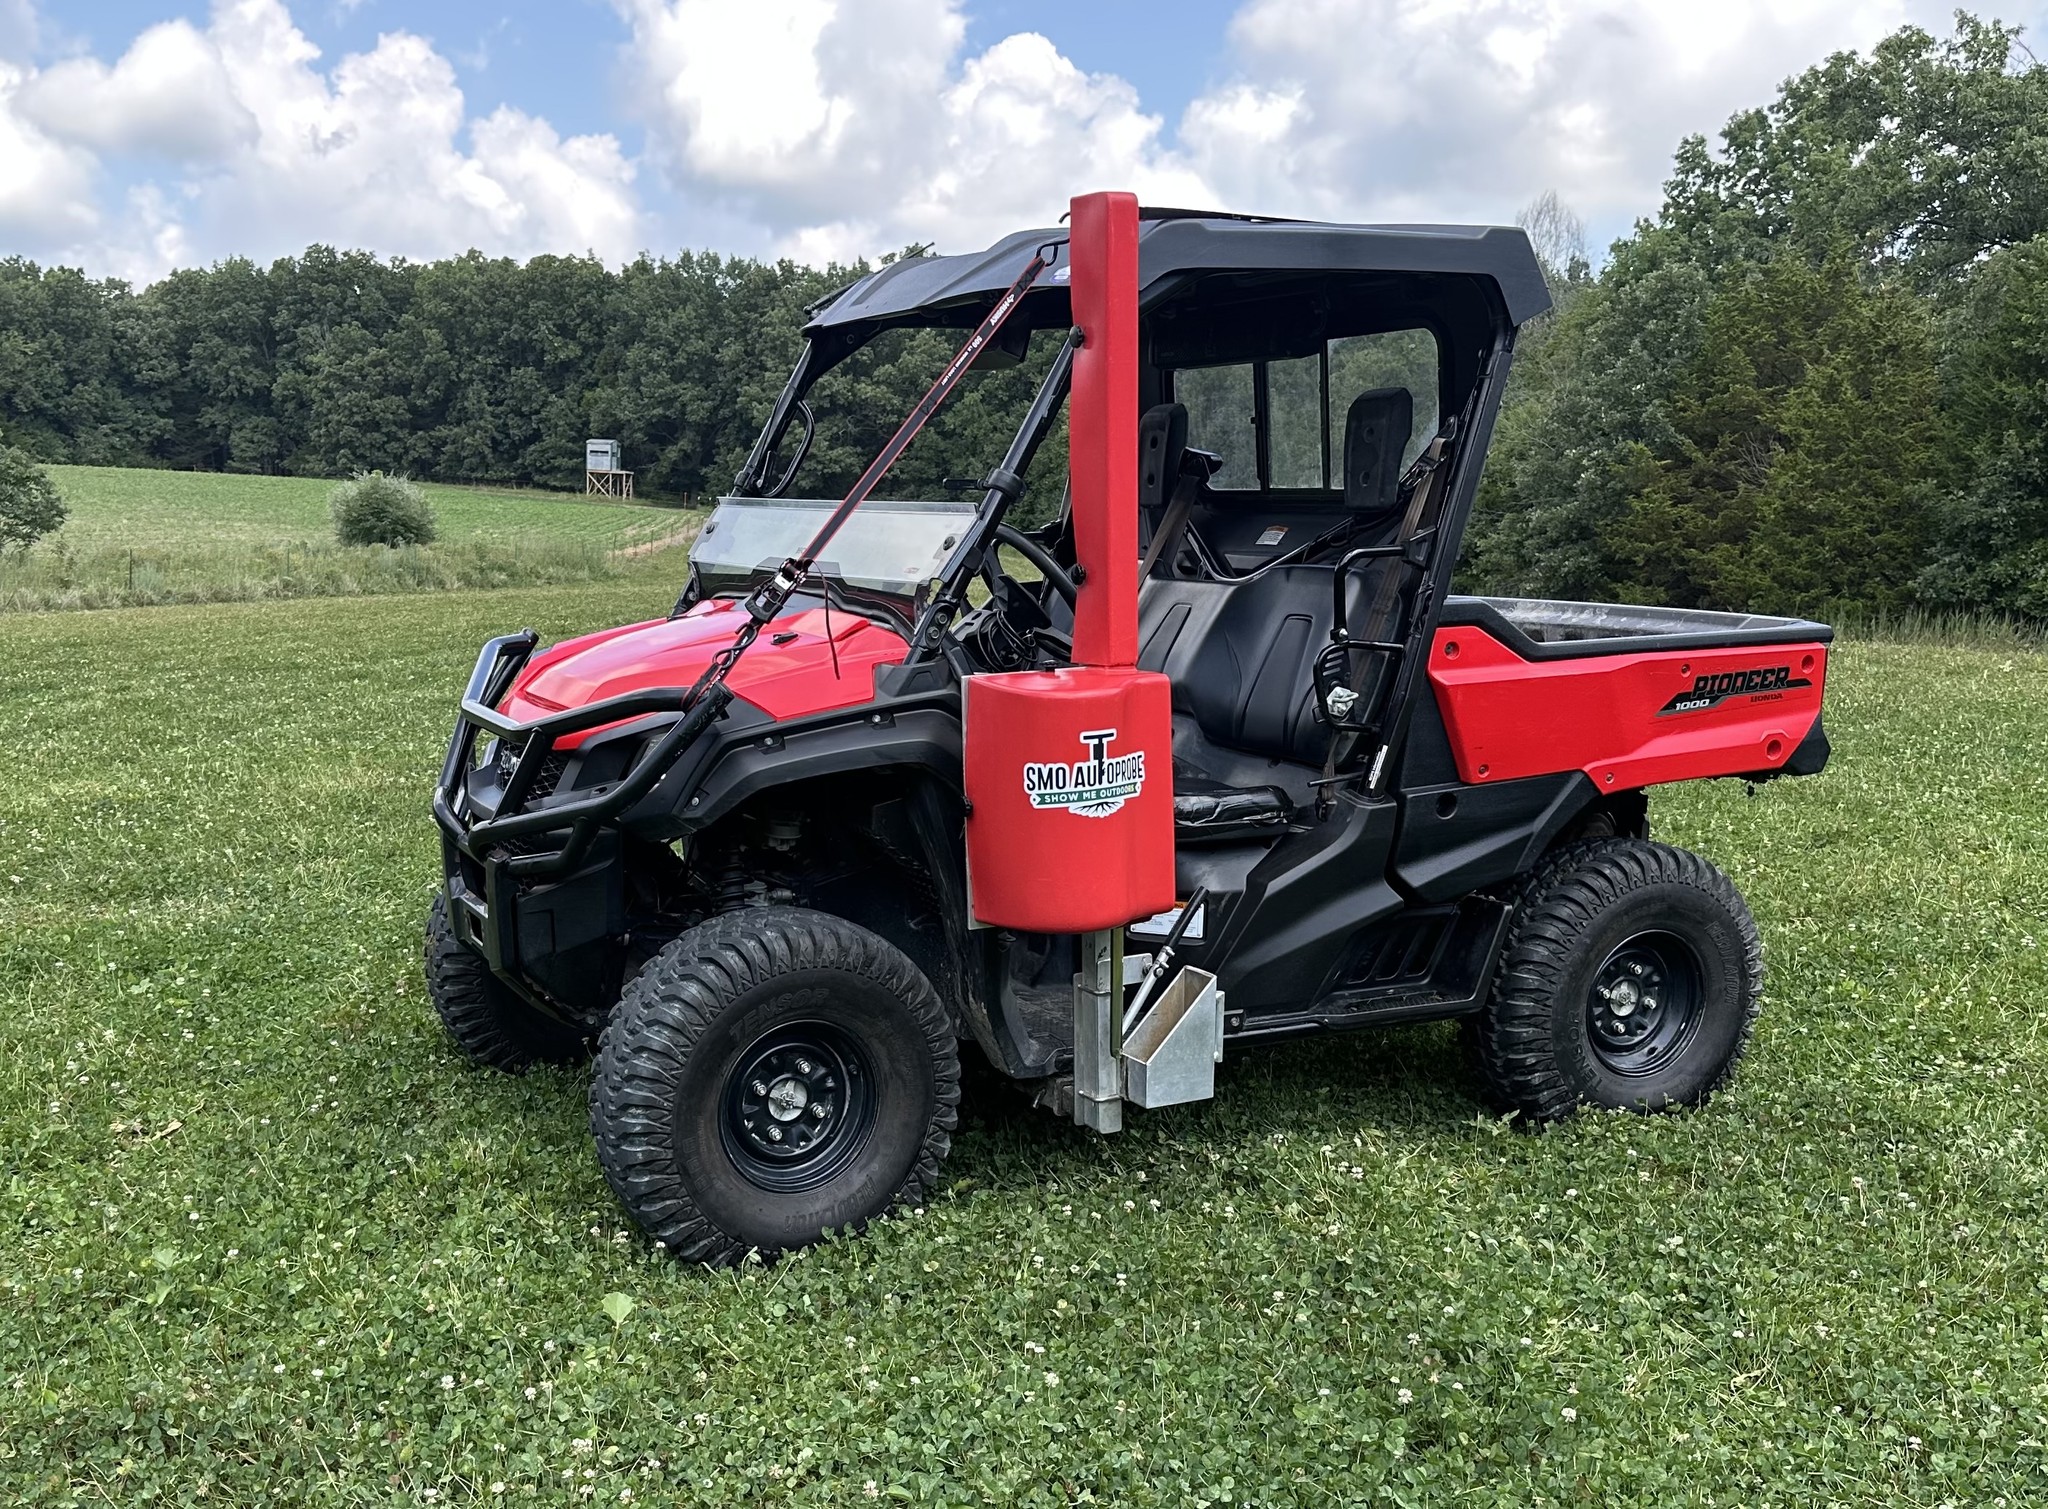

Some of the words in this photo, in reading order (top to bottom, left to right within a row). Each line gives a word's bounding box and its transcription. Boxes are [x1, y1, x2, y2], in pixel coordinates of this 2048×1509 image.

[990, 301, 1009, 326] HUSKY
[1691, 666, 1791, 699] PIONEER
[1675, 699, 1710, 711] 1000
[1750, 693, 1784, 703] HONDA
[1026, 766, 1067, 792] SMO
[1074, 733, 1143, 788] AUTOPROBE
[1044, 793, 1079, 803] SHOW
[1082, 792, 1097, 800] ME
[1100, 784, 1135, 798] OUTDOORS
[729, 988, 830, 1040] TENSOR
